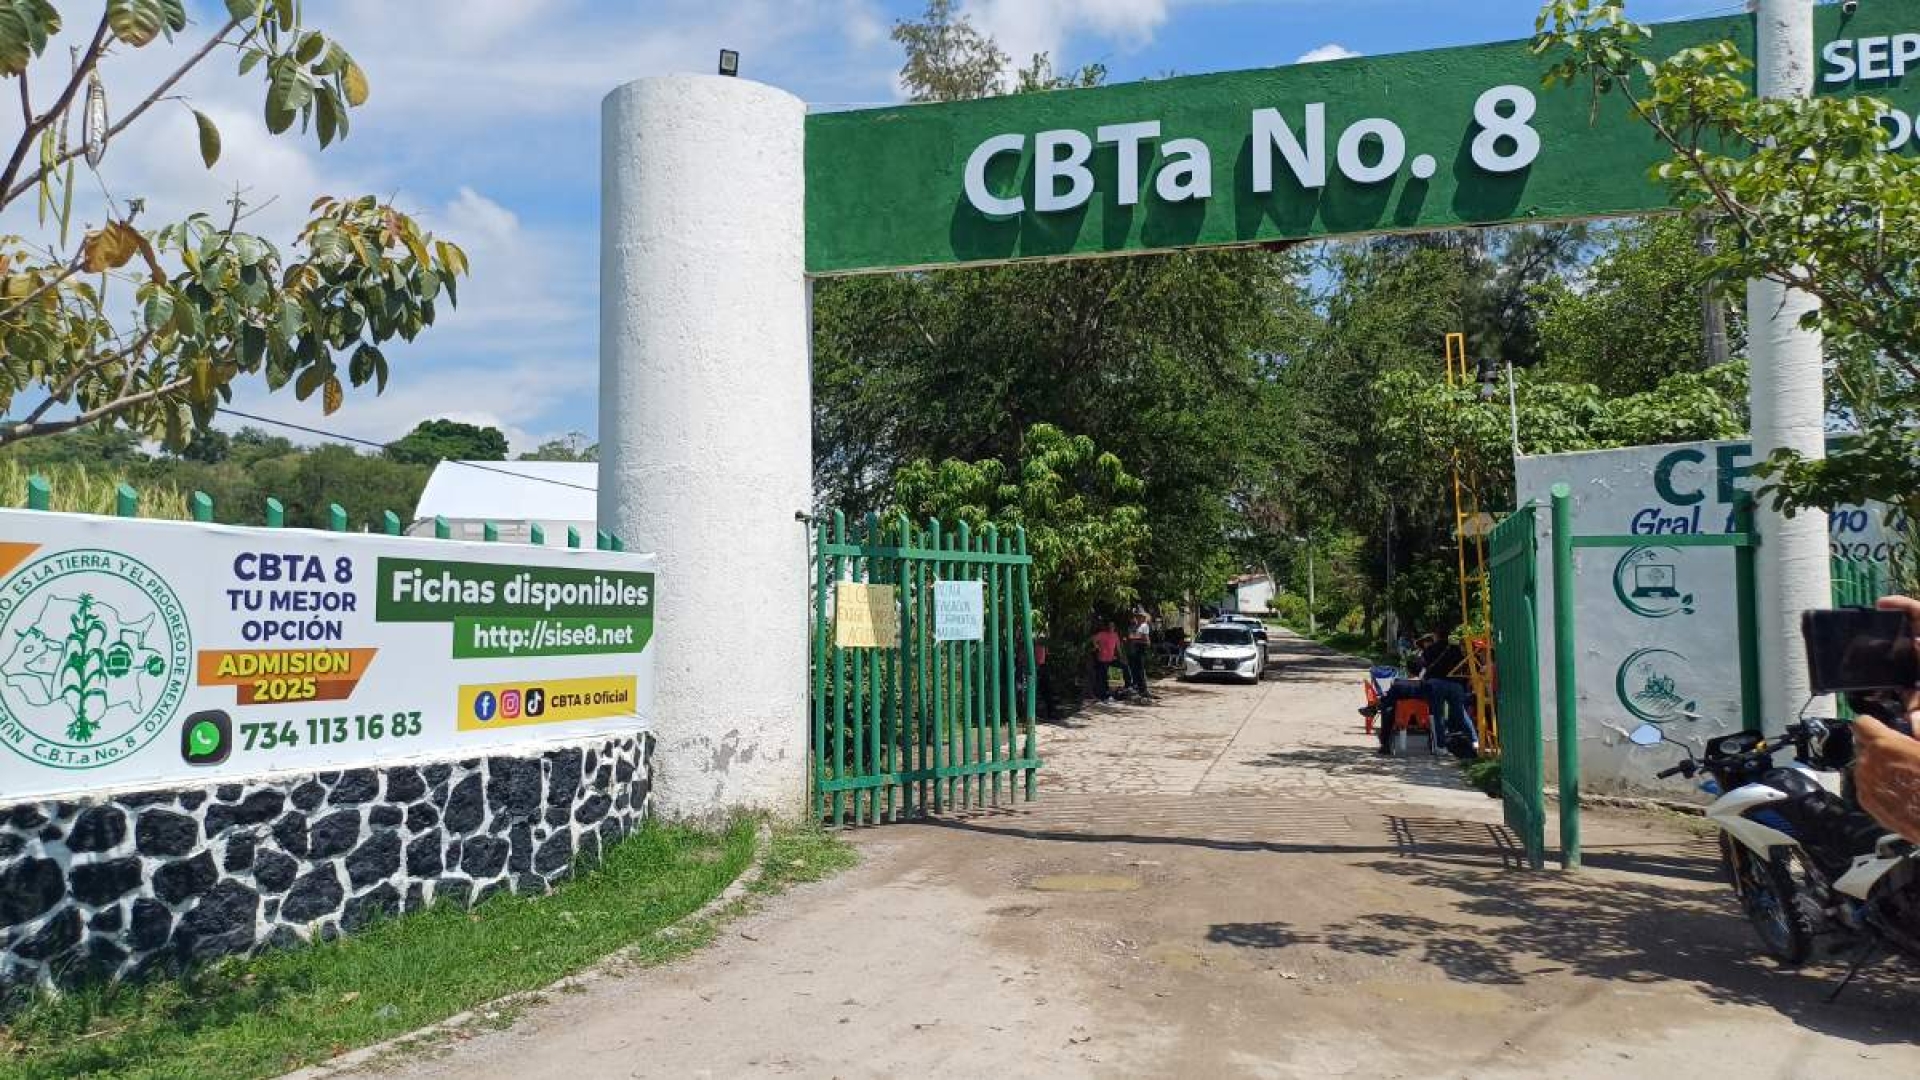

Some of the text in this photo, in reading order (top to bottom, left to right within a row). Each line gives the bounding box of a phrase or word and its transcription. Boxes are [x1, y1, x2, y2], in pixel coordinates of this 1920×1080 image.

[1823, 33, 1920, 82] SEP
[964, 85, 1540, 217] CBTa No. 8
[1631, 505, 1703, 535] Gral.
[234, 552, 352, 584] CBTA 8
[226, 589, 357, 612] TU MEJOR
[392, 568, 650, 611] Fichas disponibles
[12, 577, 33, 596] ES
[32, 564, 54, 581] LA
[56, 555, 111, 570] TIERRA
[119, 560, 129, 572] Y
[129, 566, 145, 583] EL
[146, 579, 186, 651] PROGRESO
[173, 656, 186, 675] DE
[241, 614, 342, 641] OPCIÓN
[473, 620, 633, 653] http://sise8.net
[217, 646, 351, 676] ADMISIÓN
[253, 676, 317, 700] 2025
[551, 689, 628, 708] CBTA 8 Oficial
[240, 711, 422, 751] 734 113 16 83
[32, 735, 136, 764] C.B.T.a No. 8
